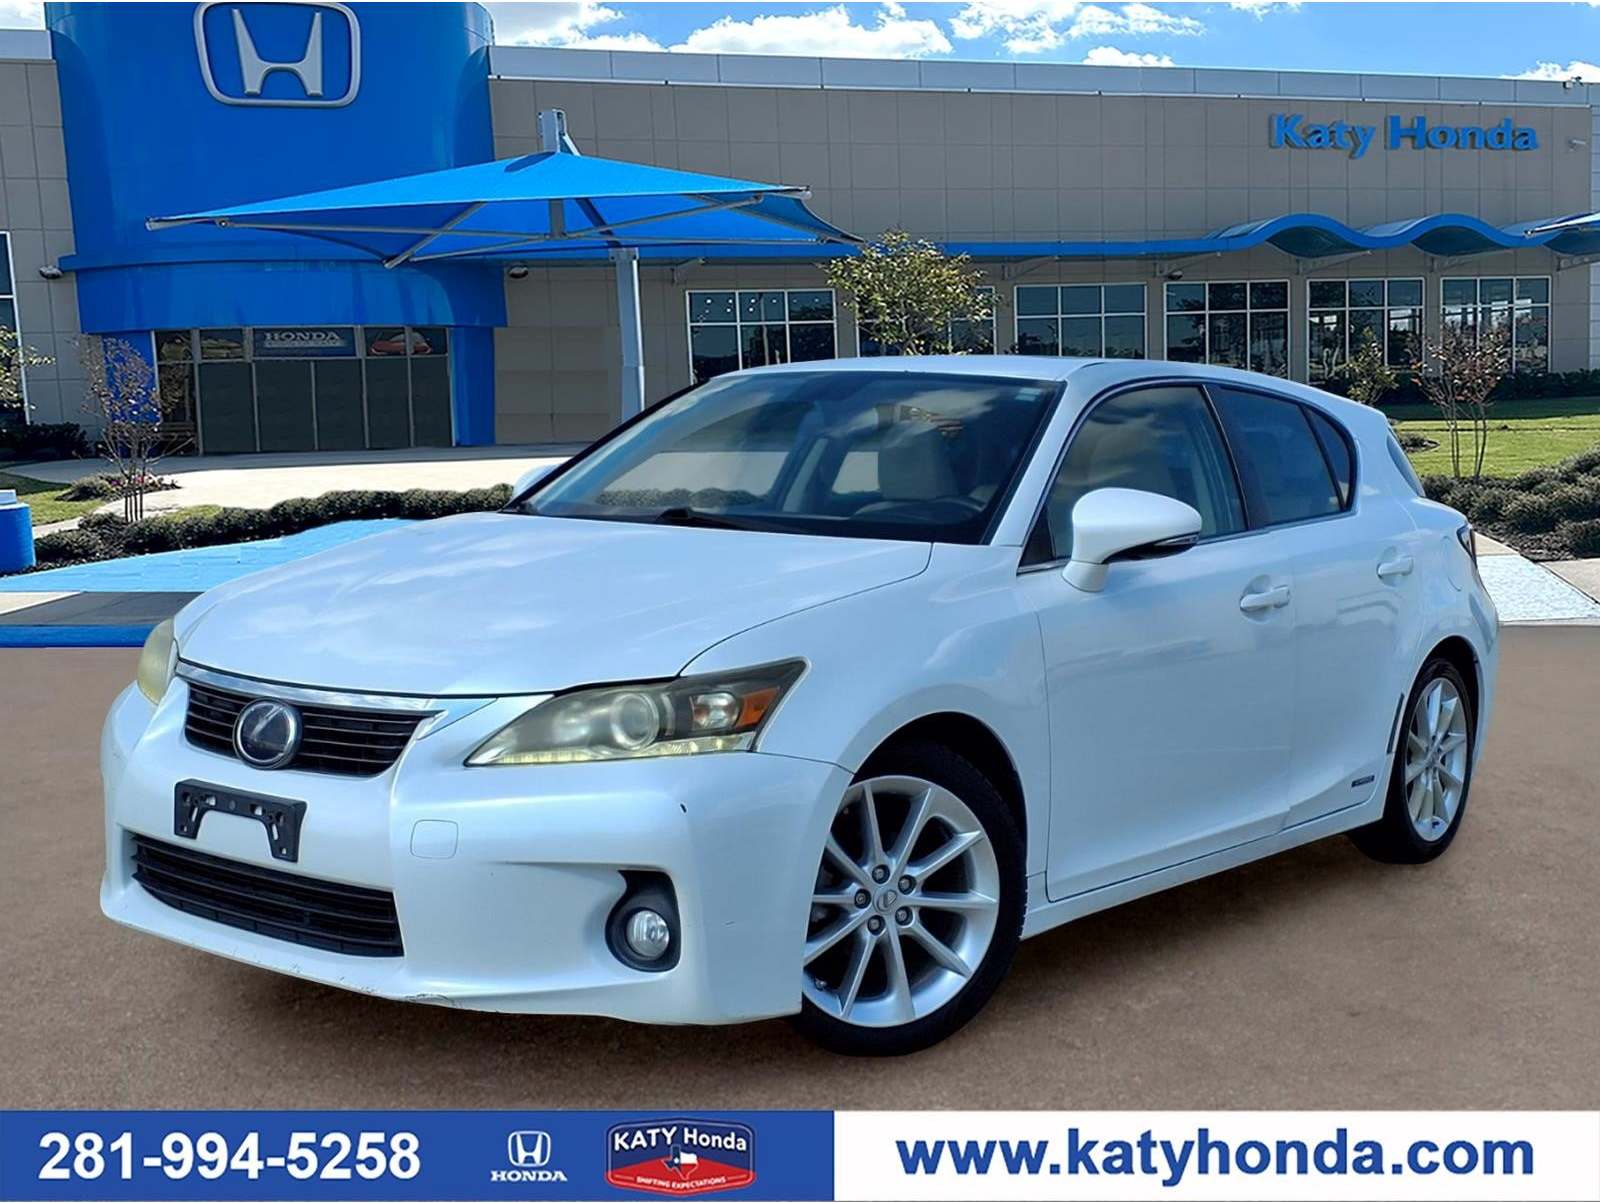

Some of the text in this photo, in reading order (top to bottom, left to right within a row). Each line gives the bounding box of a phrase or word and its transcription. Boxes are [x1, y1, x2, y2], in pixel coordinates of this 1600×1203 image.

[1270, 113, 1539, 159] Katy Honda
[263, 331, 341, 341] HONDA
